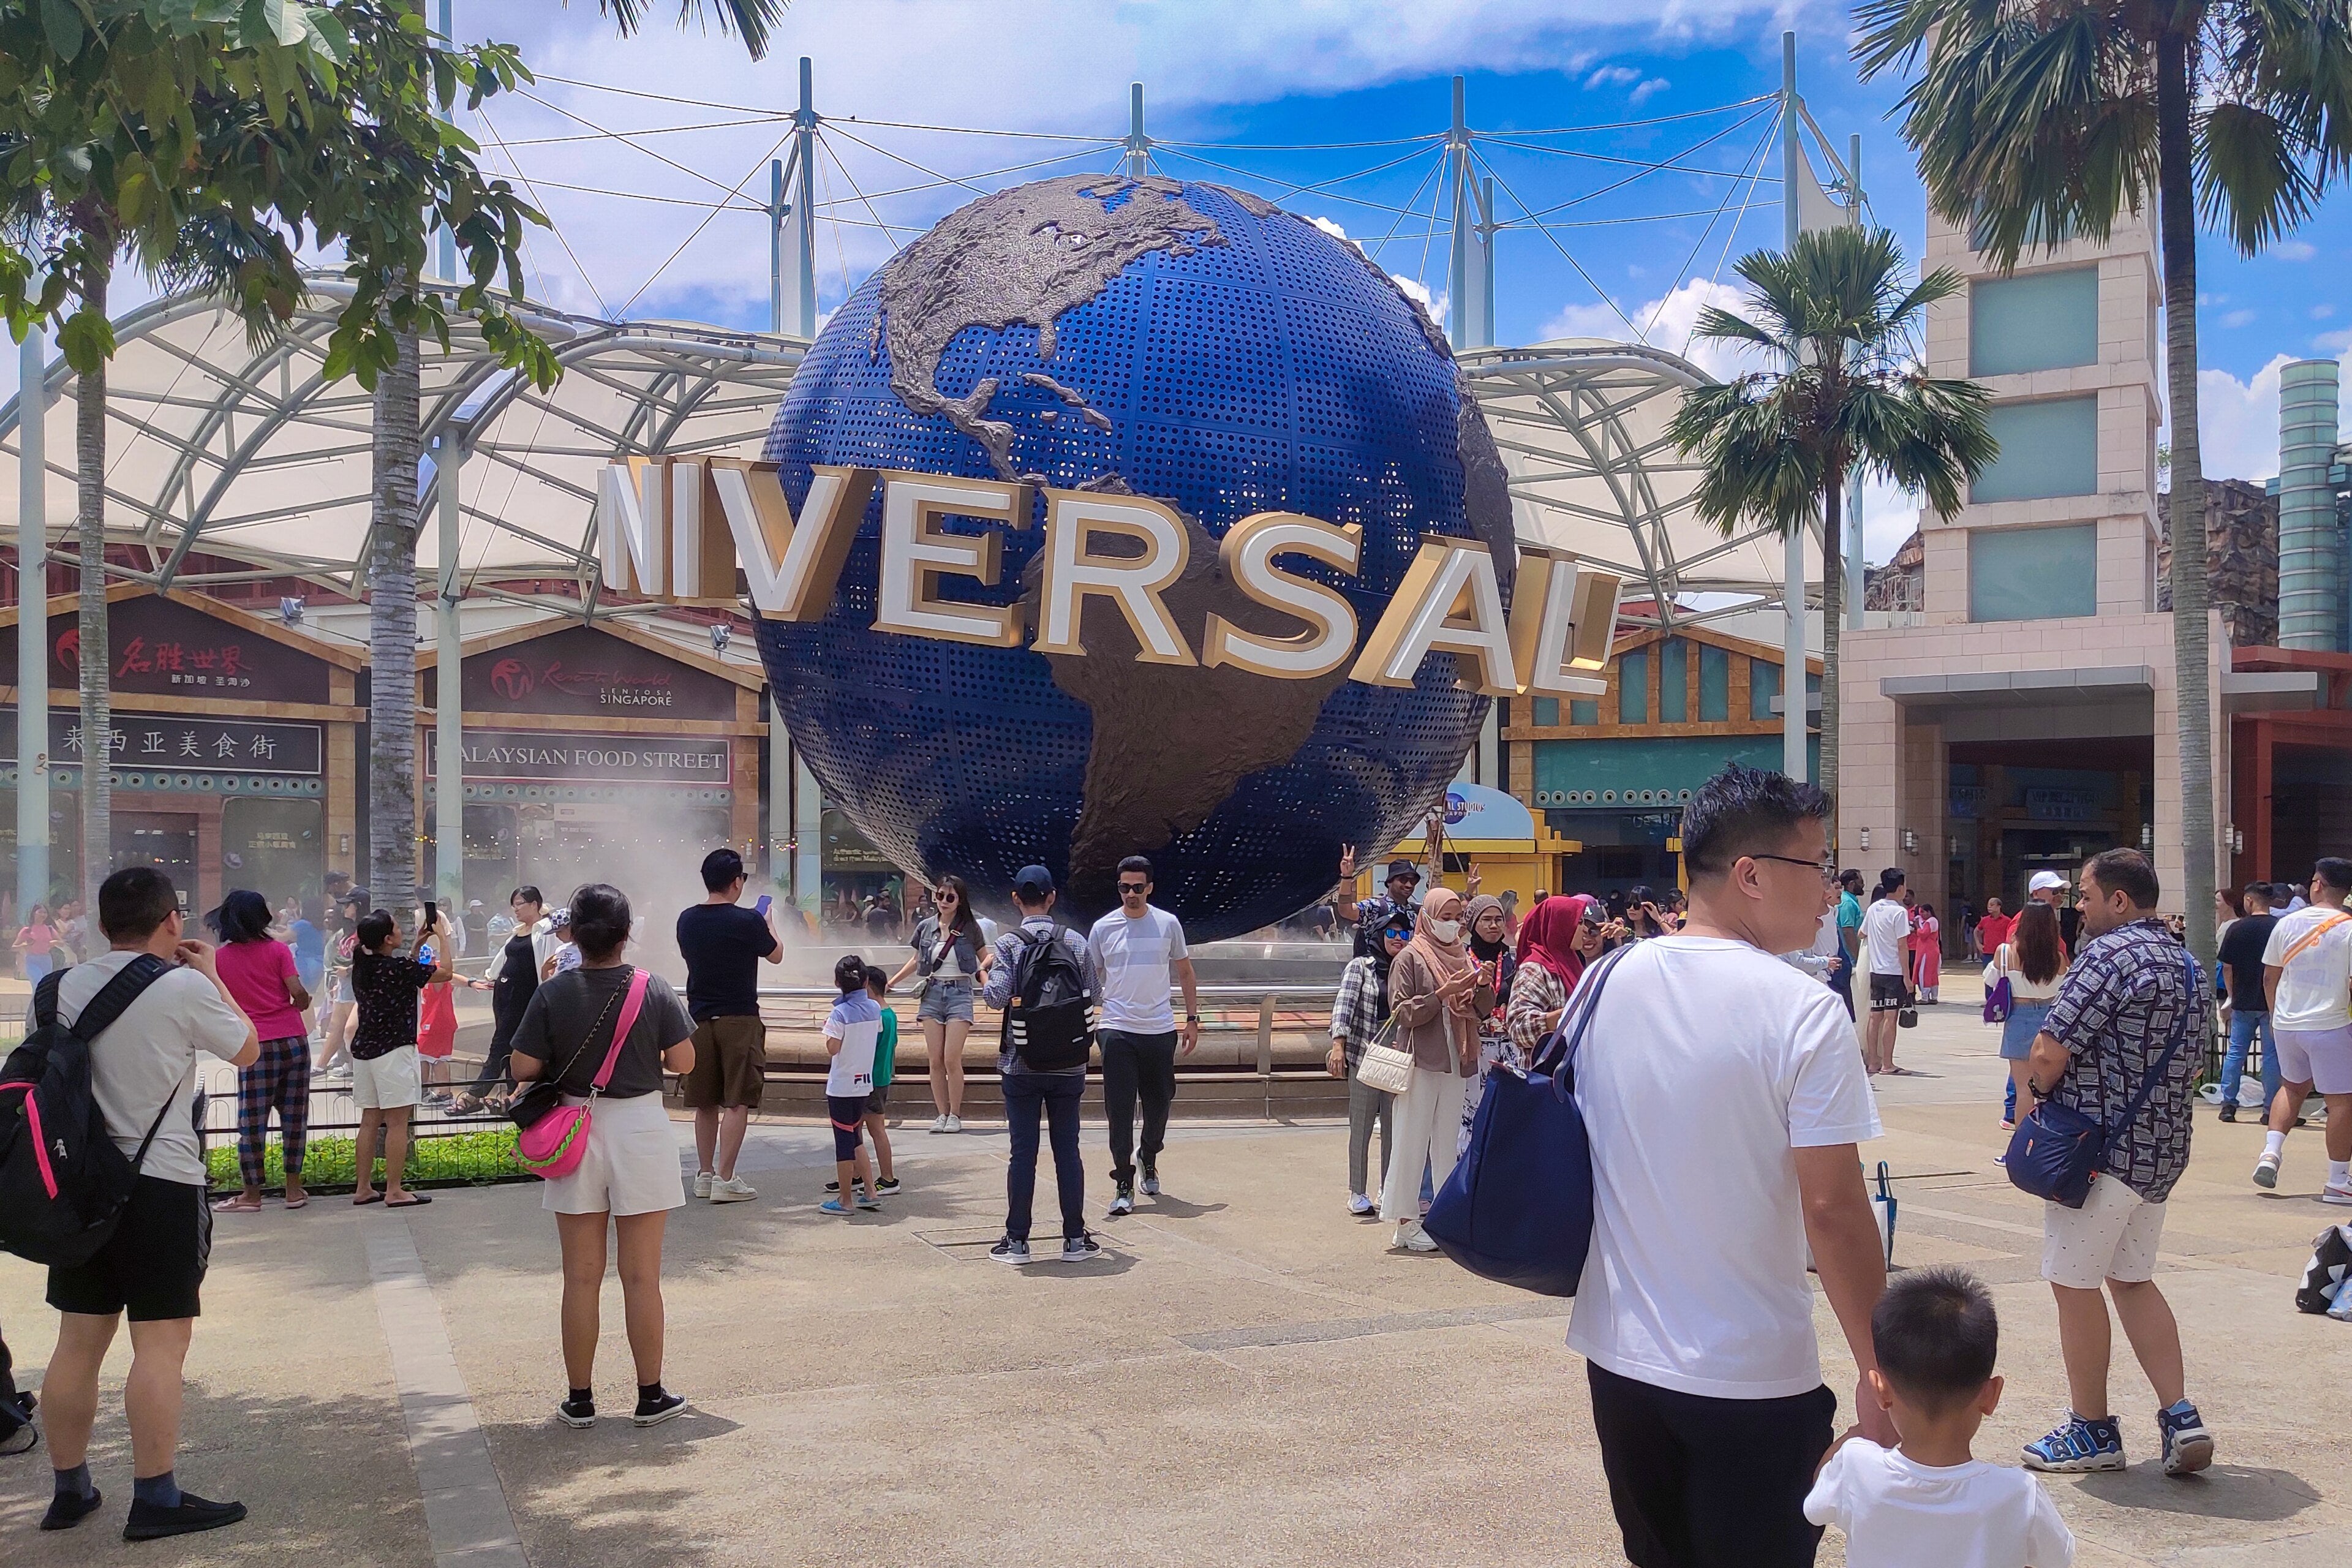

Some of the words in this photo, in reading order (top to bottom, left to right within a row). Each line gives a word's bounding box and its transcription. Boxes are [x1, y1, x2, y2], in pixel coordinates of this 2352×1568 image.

[115, 636, 252, 677] 名胜世界
[172, 674, 207, 684] 新加坡
[600, 695, 673, 706] SINGAPORE
[434, 745, 567, 765] ALAYSIAN
[575, 750, 637, 766] FOOD
[643, 752, 725, 769] STREET
[1457, 802, 1486, 813] STUDIOS
